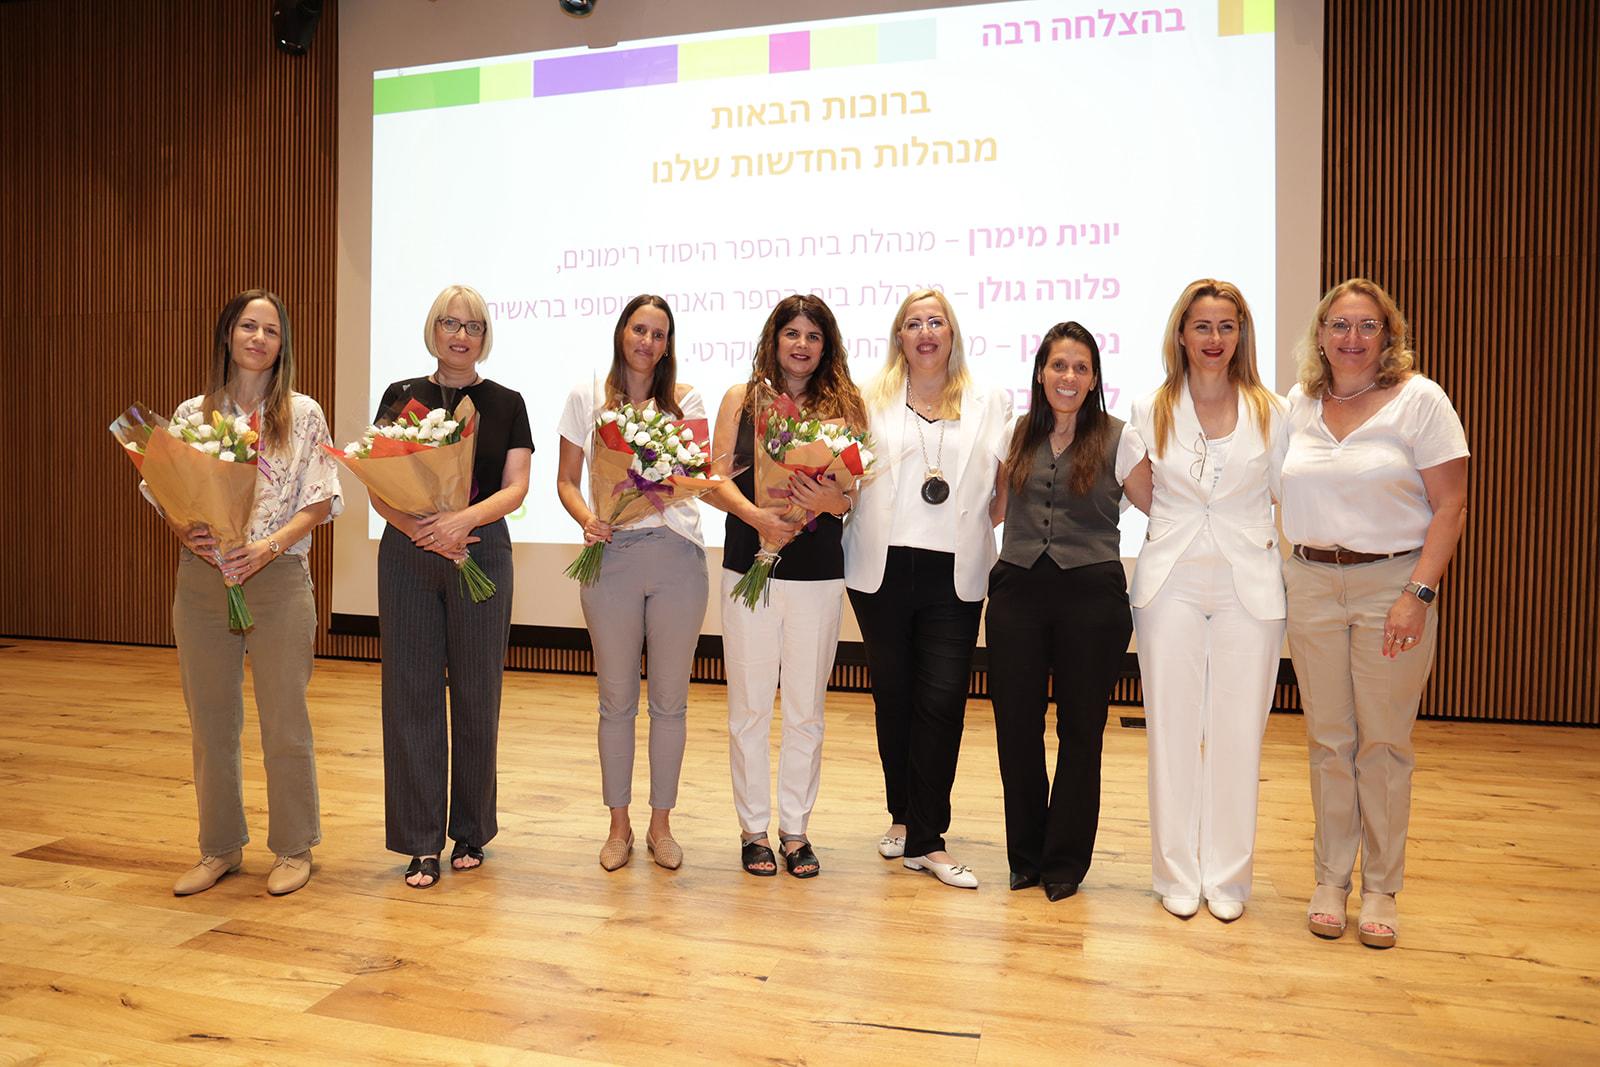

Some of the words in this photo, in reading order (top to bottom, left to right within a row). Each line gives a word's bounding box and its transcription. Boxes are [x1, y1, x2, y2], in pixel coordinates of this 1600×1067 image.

[981, 19, 1042, 47] רבה
[1051, 7, 1187, 42] בהצלחה
[710, 98, 812, 130] הבאות
[822, 90, 932, 122] ברוכות
[730, 146, 863, 179] החדשות
[873, 135, 998, 169] מנהלות
[651, 153, 721, 184] שלנו
[725, 238, 790, 260] הספר
[799, 236, 841, 257] בית
[850, 228, 936, 256] מנהלת
[968, 225, 1048, 257] מימרן
[1057, 222, 1121, 247] יונית
[556, 247, 641, 274] רימונים,
[648, 243, 717, 267] היסודי
[978, 276, 1027, 310] גולן
[1036, 273, 1121, 302] פלורה
